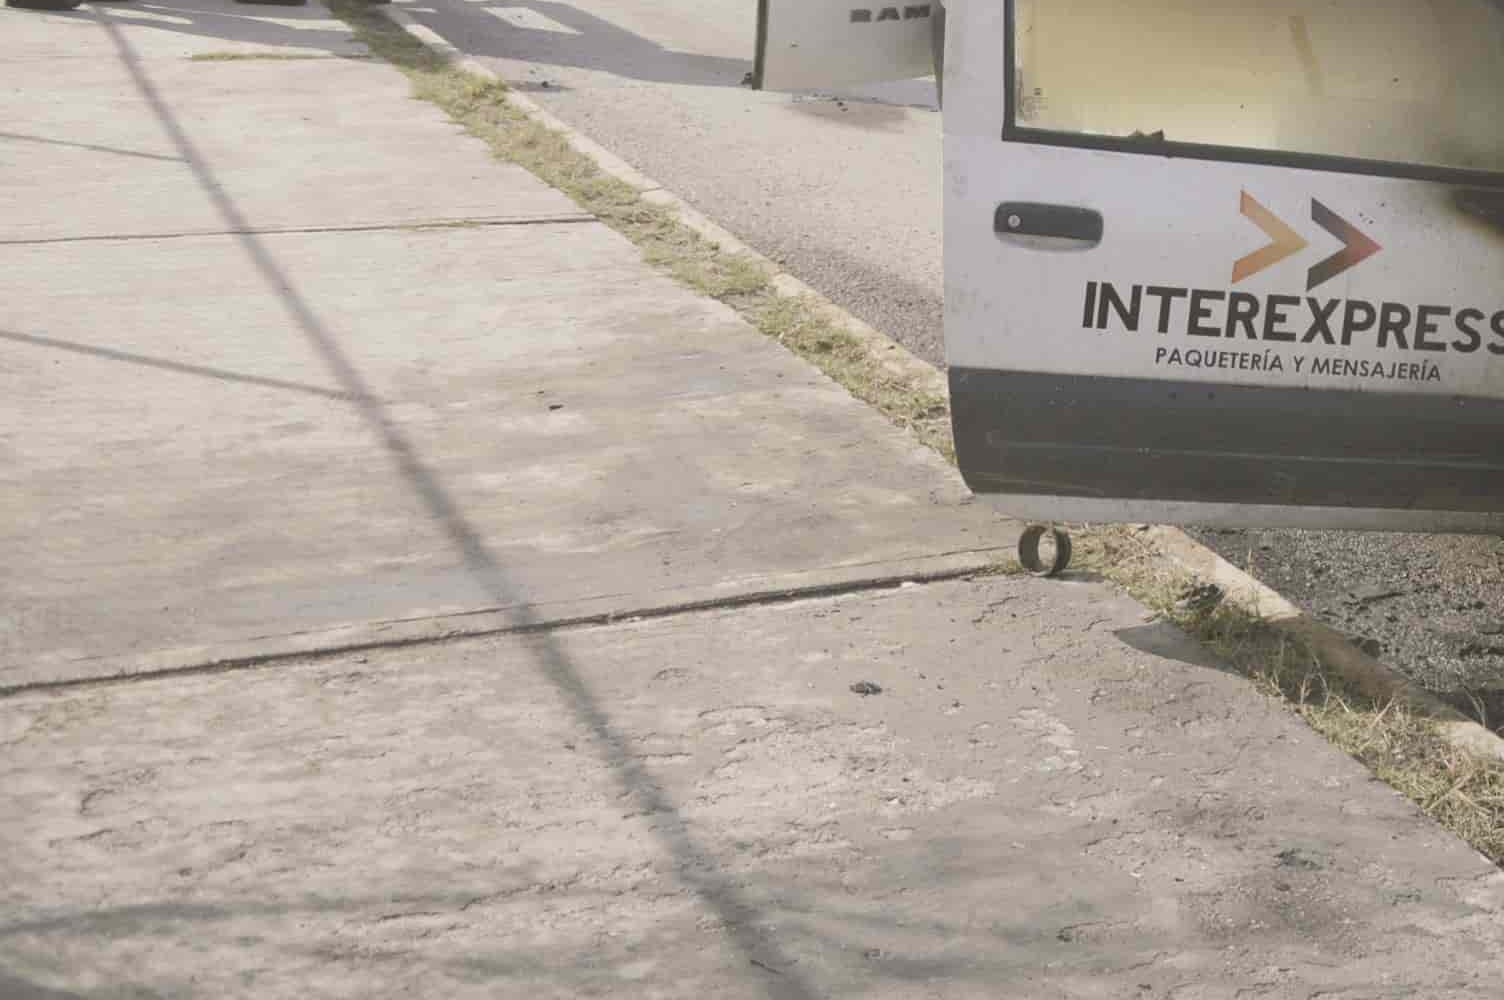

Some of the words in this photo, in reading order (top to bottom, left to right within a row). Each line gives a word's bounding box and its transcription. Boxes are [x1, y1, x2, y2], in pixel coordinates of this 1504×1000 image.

[1155, 347, 1284, 371] PAQUETERÍA
[1293, 356, 1304, 373] Y
[1311, 356, 1441, 382] MENSAJERÍA
